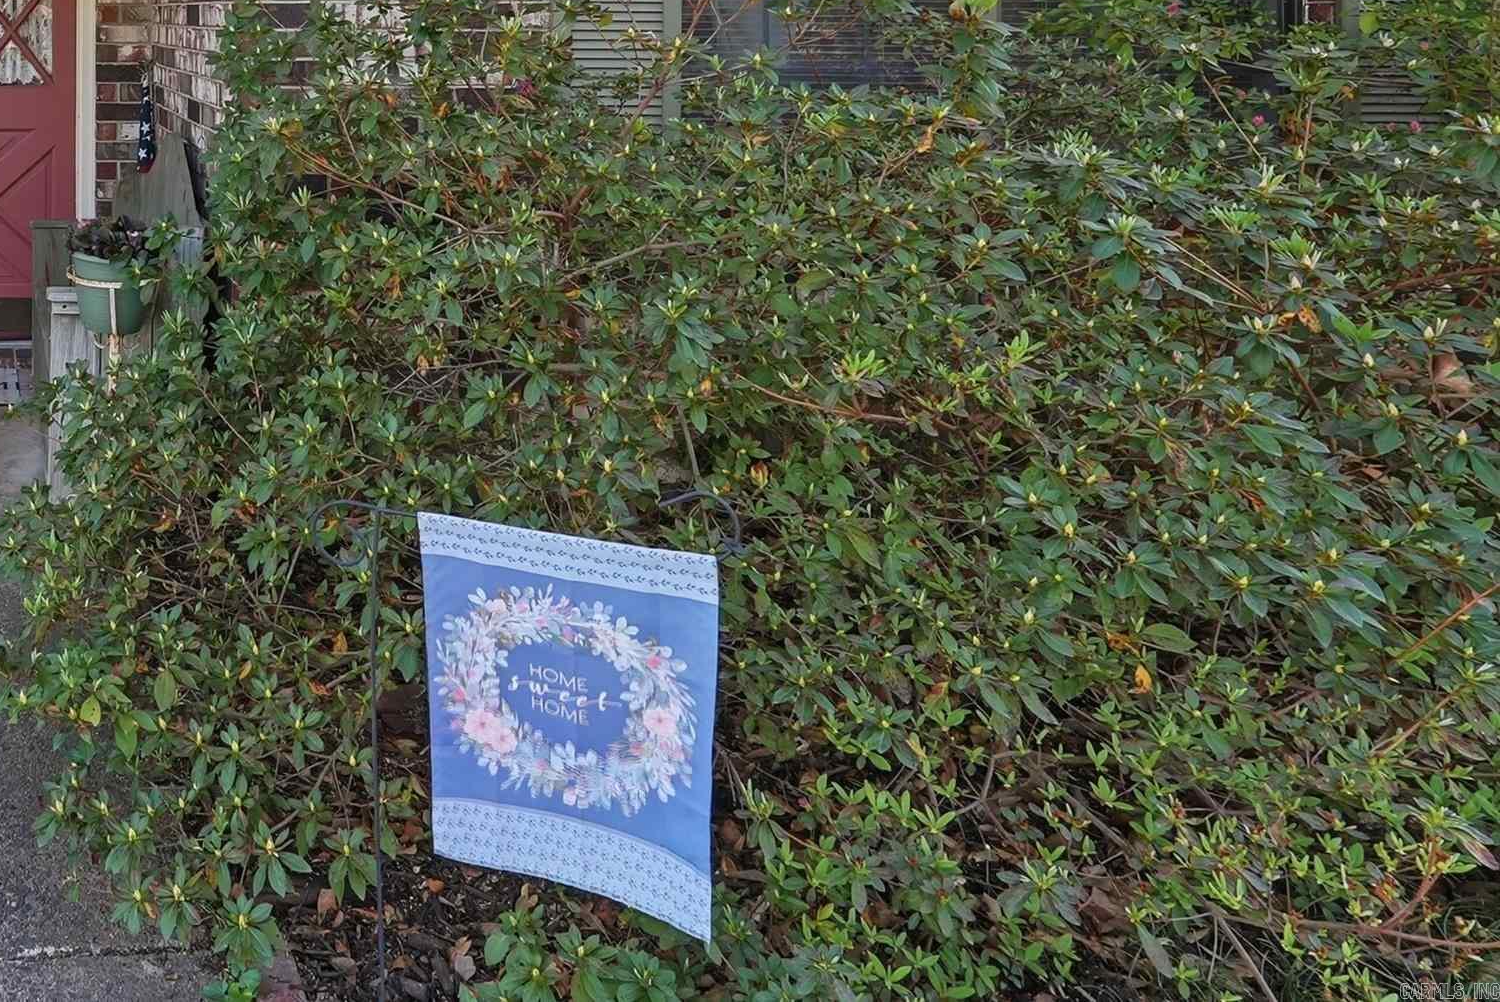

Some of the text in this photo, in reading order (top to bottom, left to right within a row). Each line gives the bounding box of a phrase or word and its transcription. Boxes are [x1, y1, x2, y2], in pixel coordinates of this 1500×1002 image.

[508, 675, 622, 711] sweet
[529, 663, 588, 694] HOME
[531, 695, 589, 726] HOME
